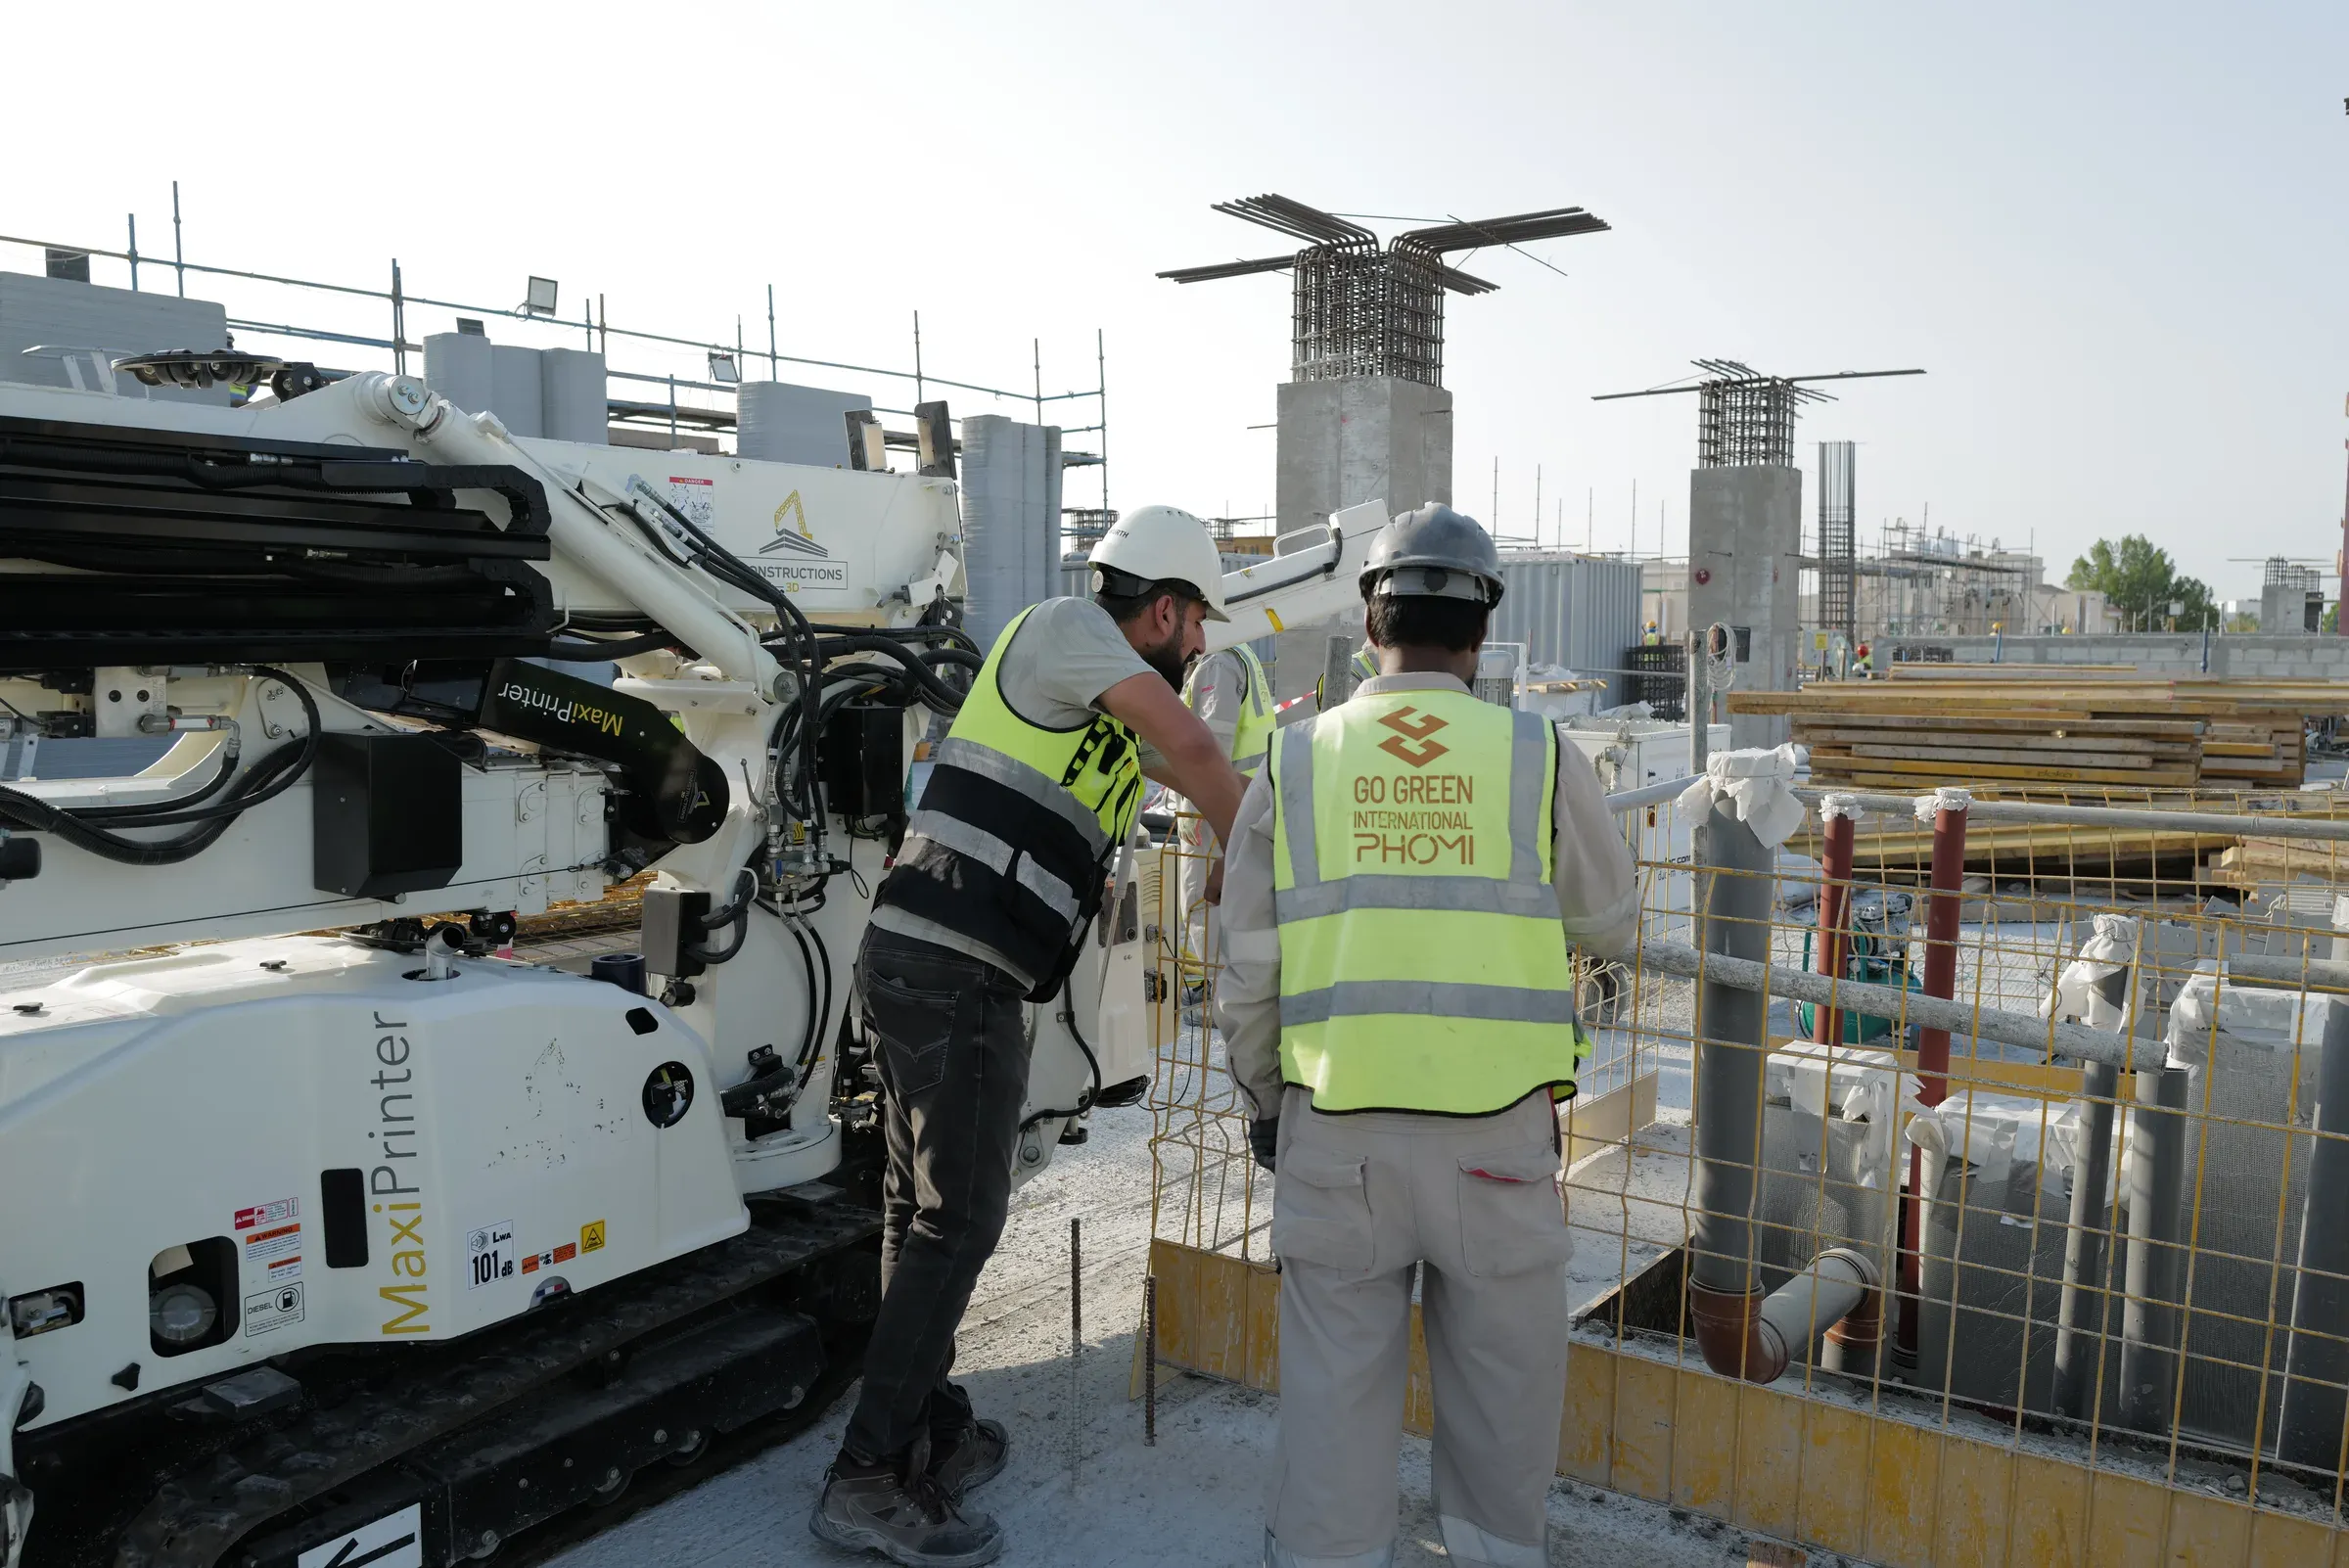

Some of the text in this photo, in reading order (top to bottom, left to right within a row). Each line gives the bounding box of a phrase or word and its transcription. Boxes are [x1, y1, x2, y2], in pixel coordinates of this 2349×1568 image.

[750, 565, 843, 580] ONSTRUCTIONS
[785, 582, 800, 593] 3D
[497, 682, 623, 737] MaxiPrinter
[1354, 775, 1473, 805] GO GREEN
[1354, 810, 1473, 830] INTERNATIONAL
[1354, 833, 1474, 865] PHOMI
[368, 1011, 430, 1335] MaxiPrinter
[261, 1226, 293, 1238] WARNING
[472, 1250, 514, 1285] 101 dB
[247, 1302, 273, 1314] DIESEL
